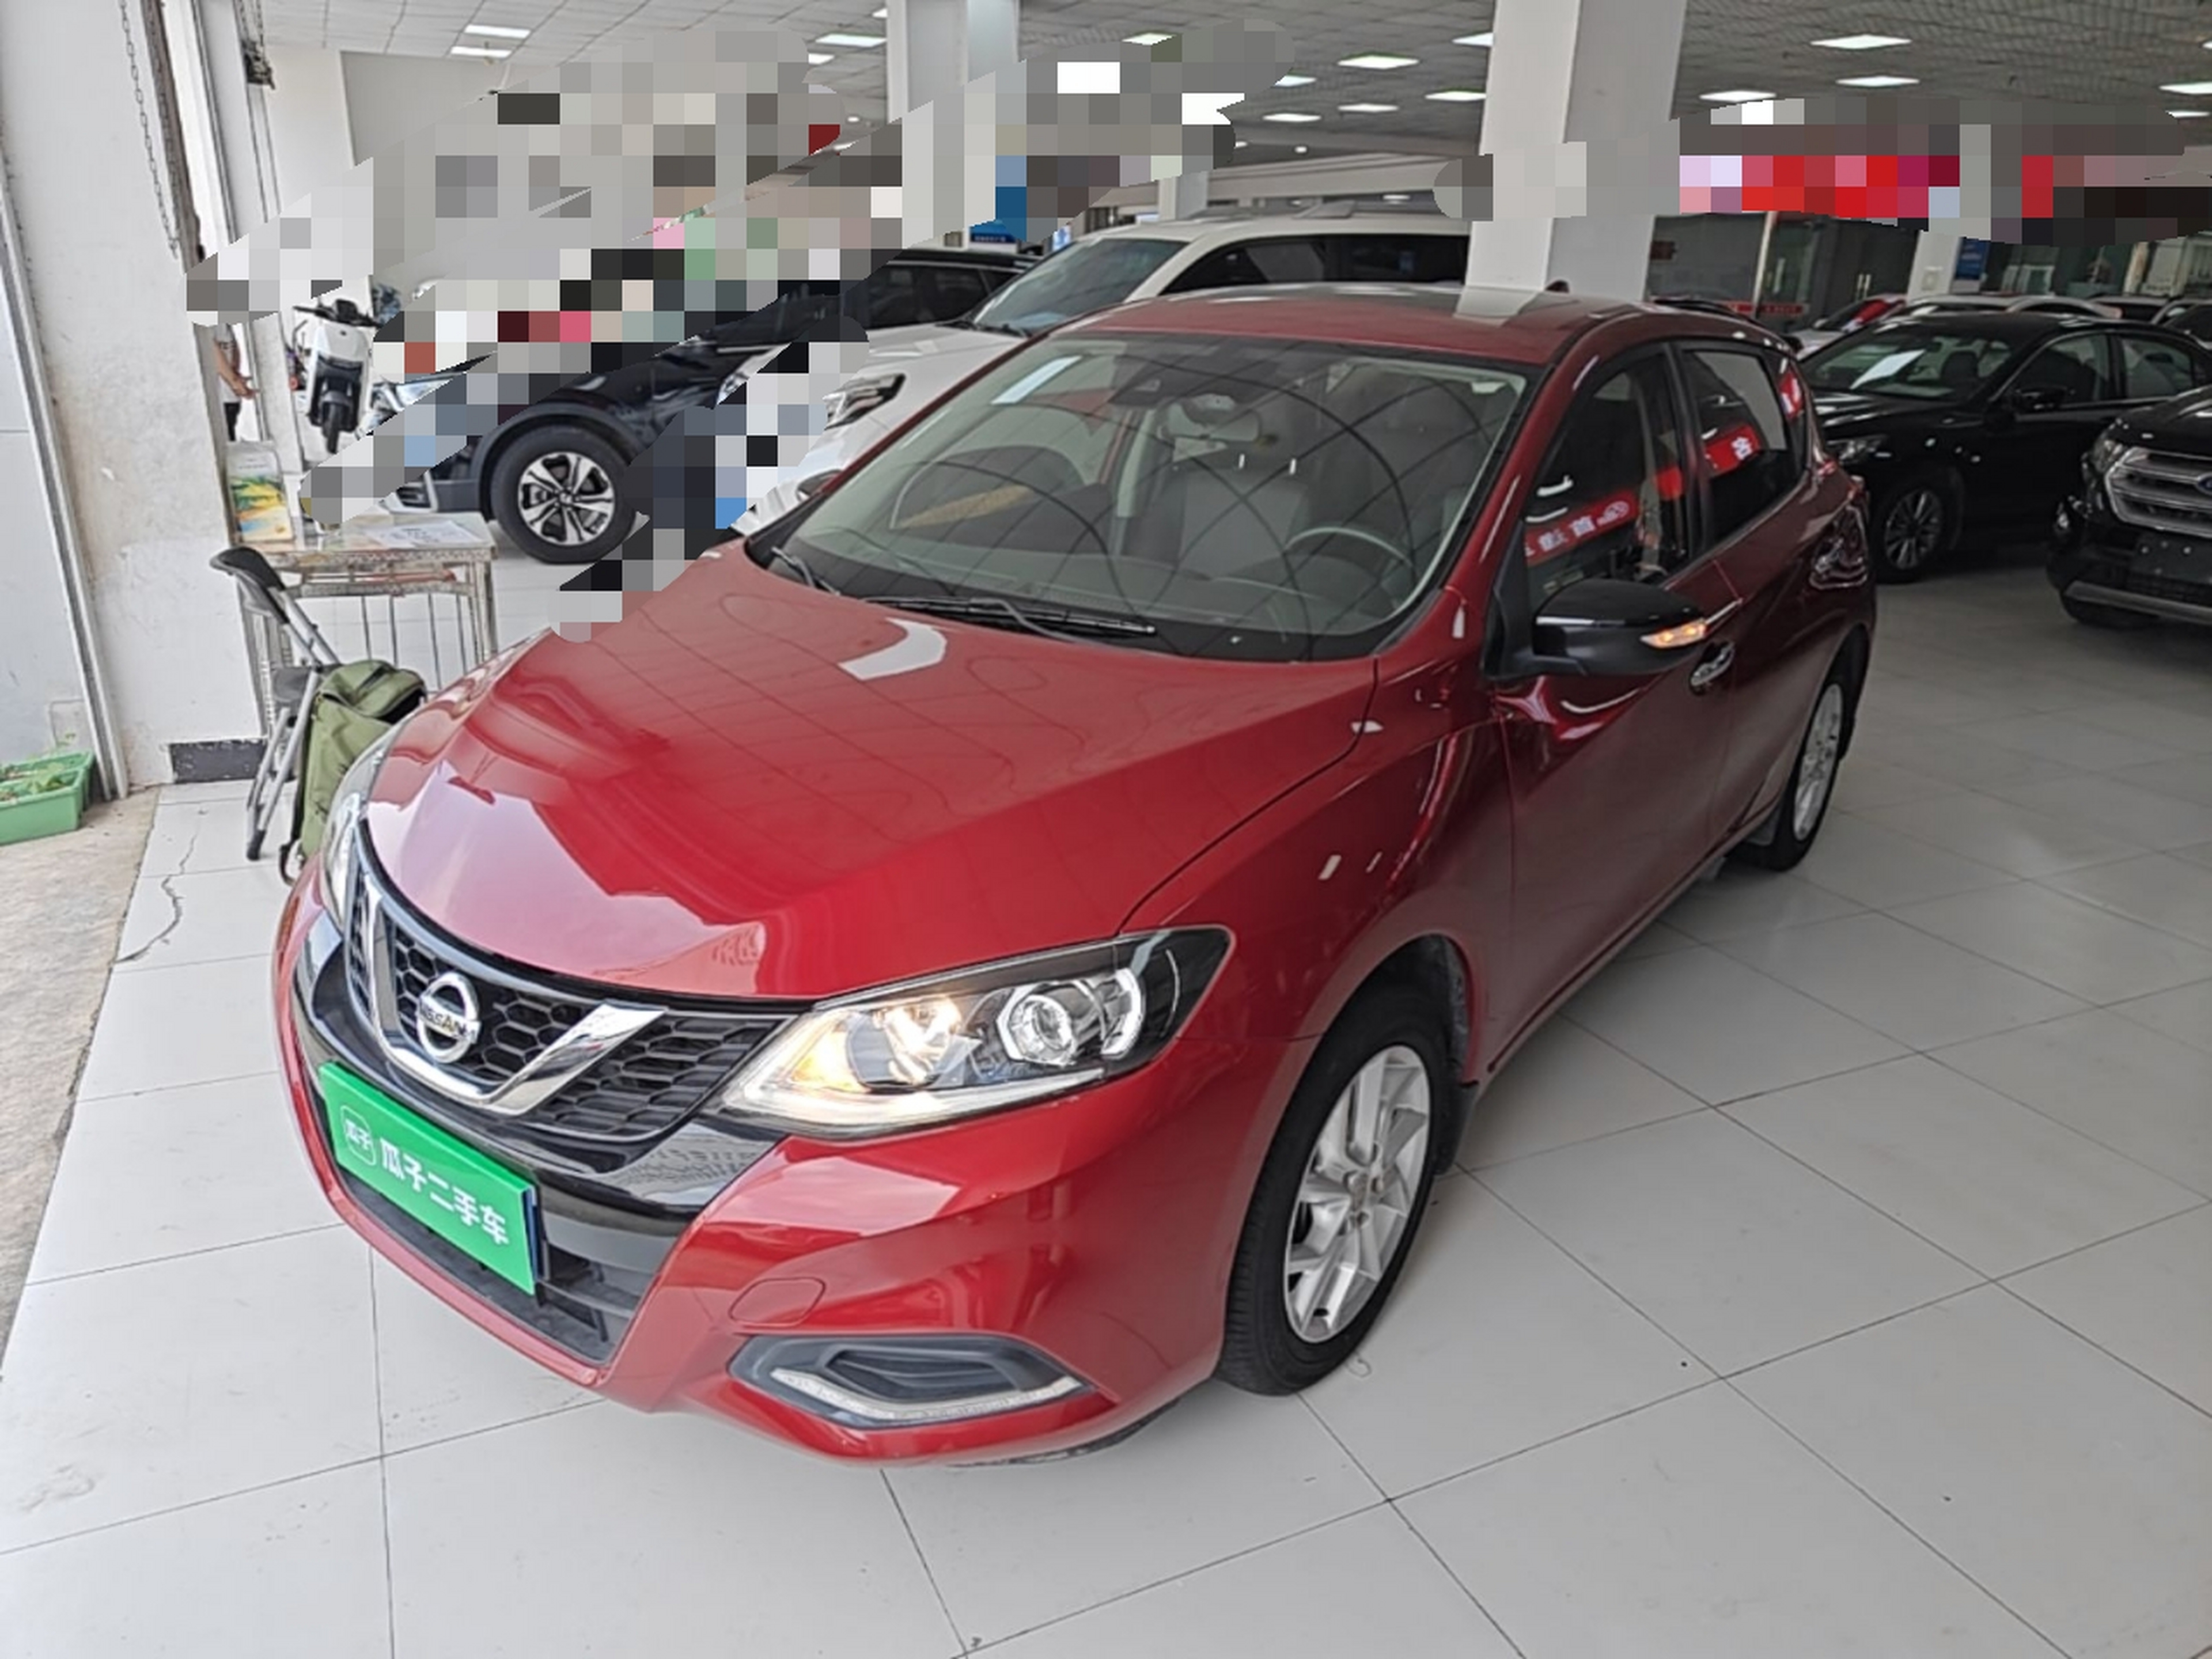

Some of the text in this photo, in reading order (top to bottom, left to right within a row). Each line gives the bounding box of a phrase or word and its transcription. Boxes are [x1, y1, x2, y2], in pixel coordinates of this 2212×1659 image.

[380, 1137, 509, 1245] 瓜子二手车
